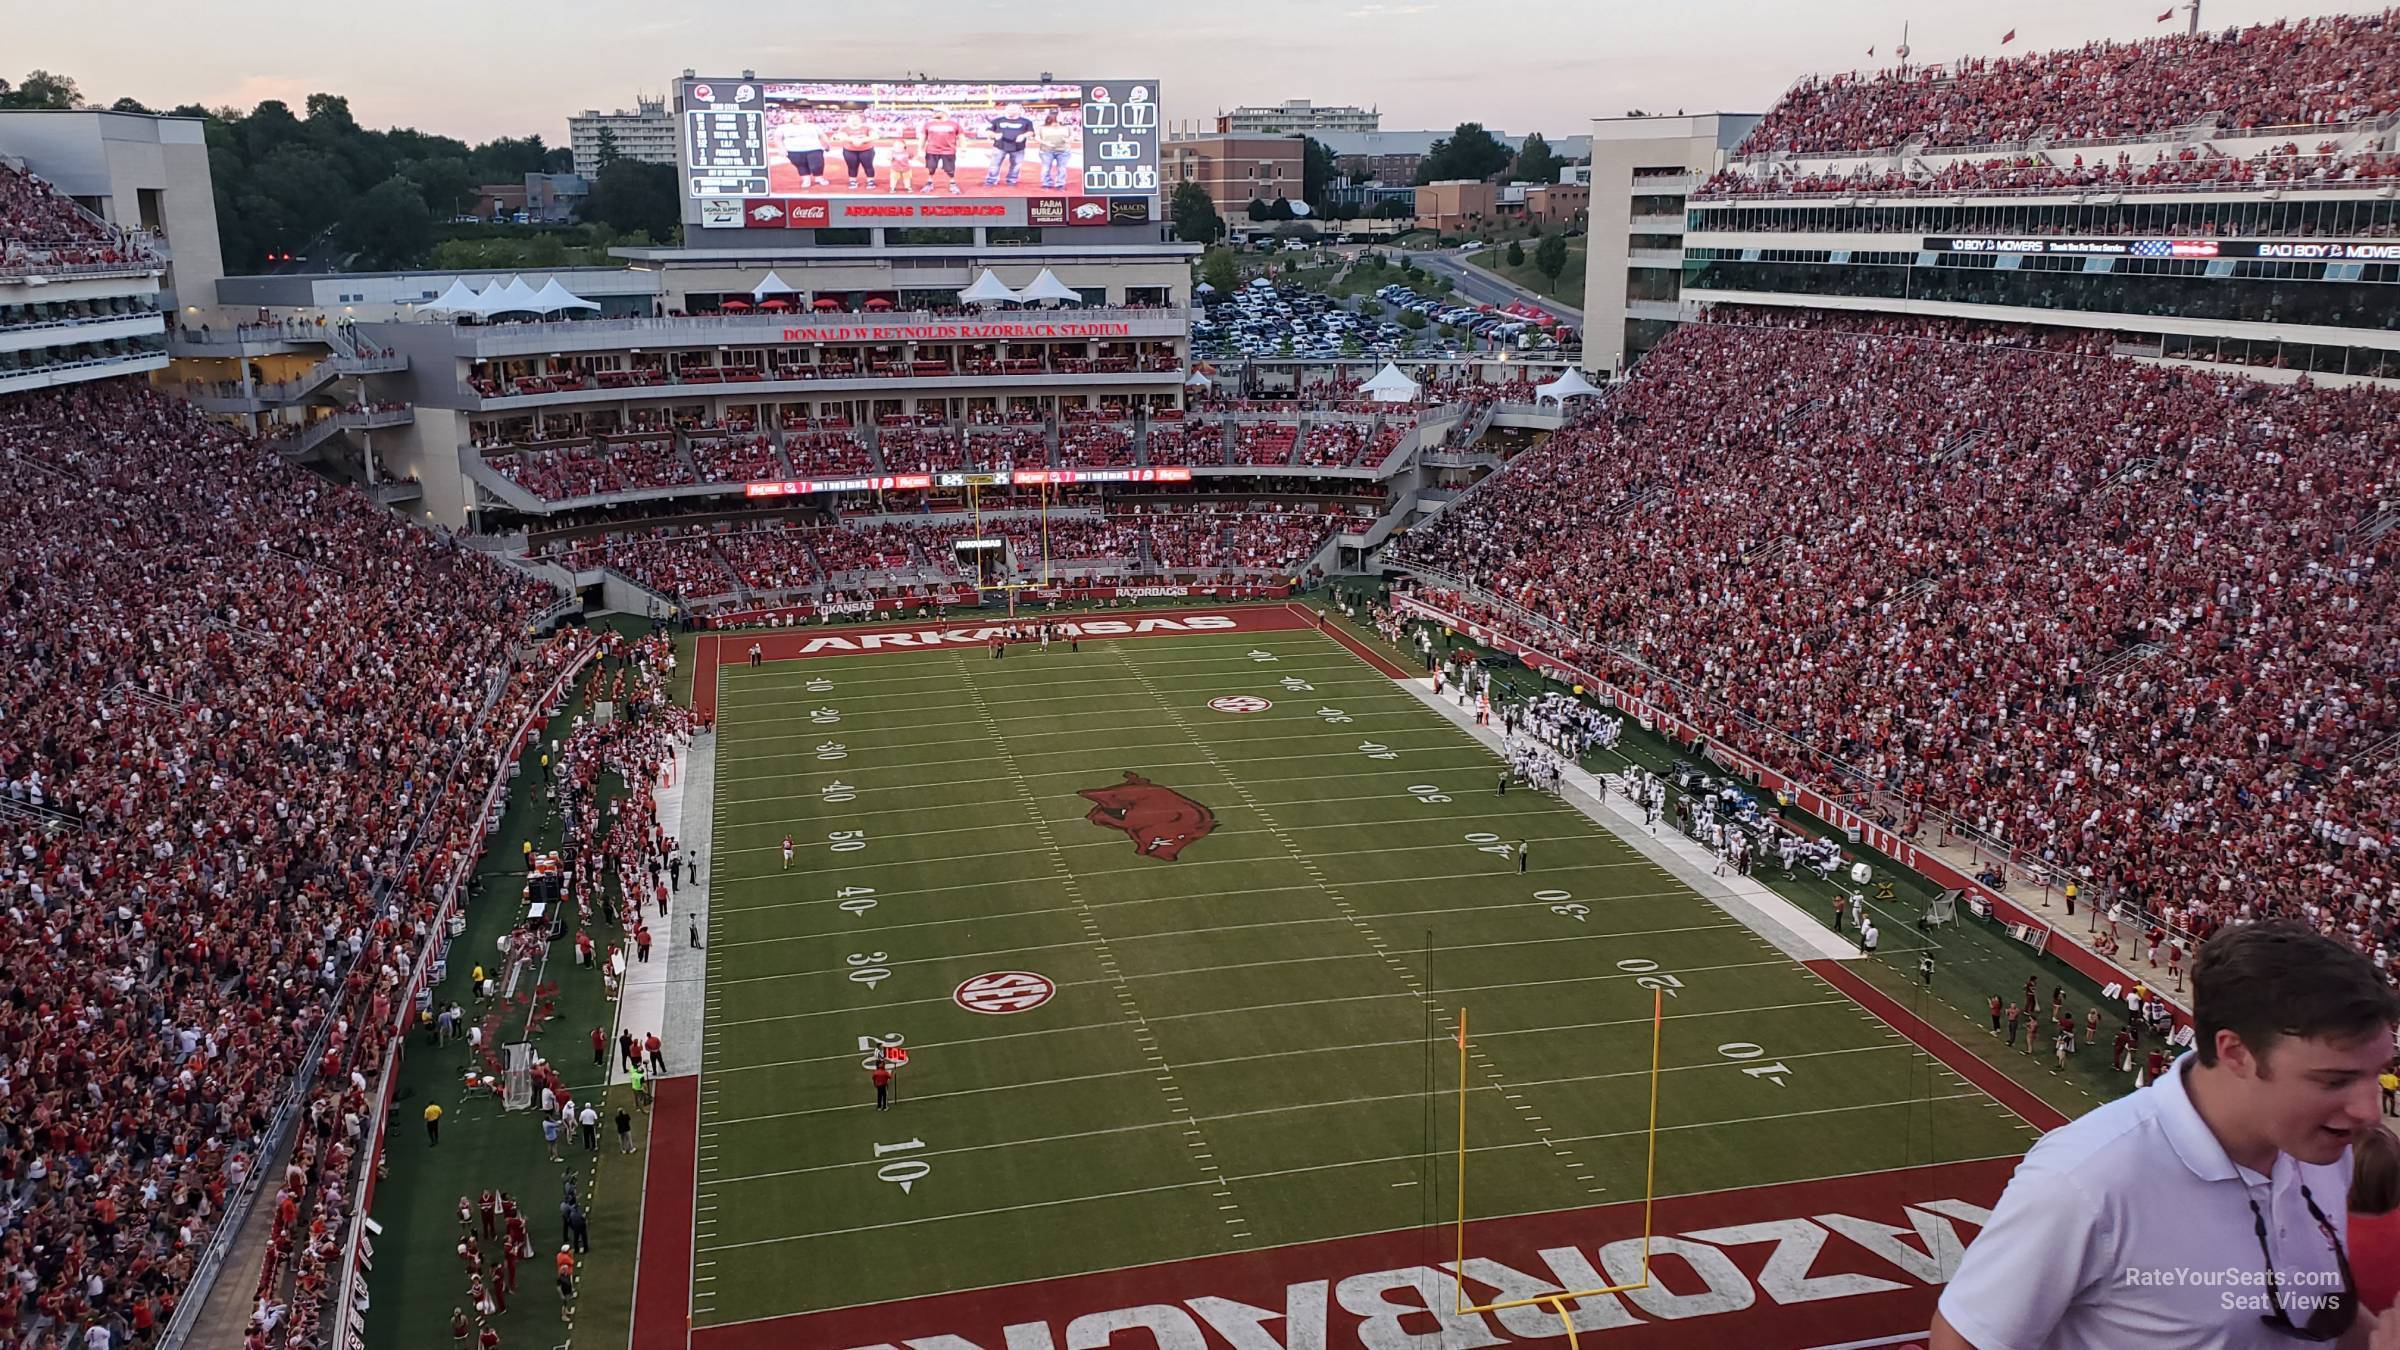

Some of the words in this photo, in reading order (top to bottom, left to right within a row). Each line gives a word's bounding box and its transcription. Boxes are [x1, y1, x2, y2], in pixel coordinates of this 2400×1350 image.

[1096, 106, 1104, 125] 7
[1132, 106, 1145, 125] 17
[845, 206, 913, 217] ARKANSAS
[920, 206, 1006, 216] RAZORBACKS
[1031, 207, 1063, 215] BUREAU
[1965, 240, 1985, 250] BOY
[1997, 241, 2043, 252] MOWERS
[2260, 244, 2292, 256] BAD
[2294, 245, 2327, 257] BOY
[783, 328, 850, 341] DONALD
[854, 328, 867, 339] W
[873, 326, 956, 339] REYNOLDS
[961, 325, 1056, 337] RAZORBACK
[1060, 323, 1128, 336] STADIUM
[956, 540, 1001, 549] ARKANSAS
[1407, 784, 1453, 804] 50
[828, 830, 866, 852] 50
[1464, 832, 1516, 857] 40
[837, 886, 878, 911] 40
[1533, 890, 1591, 916] 30
[846, 951, 892, 983] 30
[1616, 959, 1686, 990] 20
[1717, 1042, 1793, 1079] 10
[873, 1137, 931, 1182] 10
